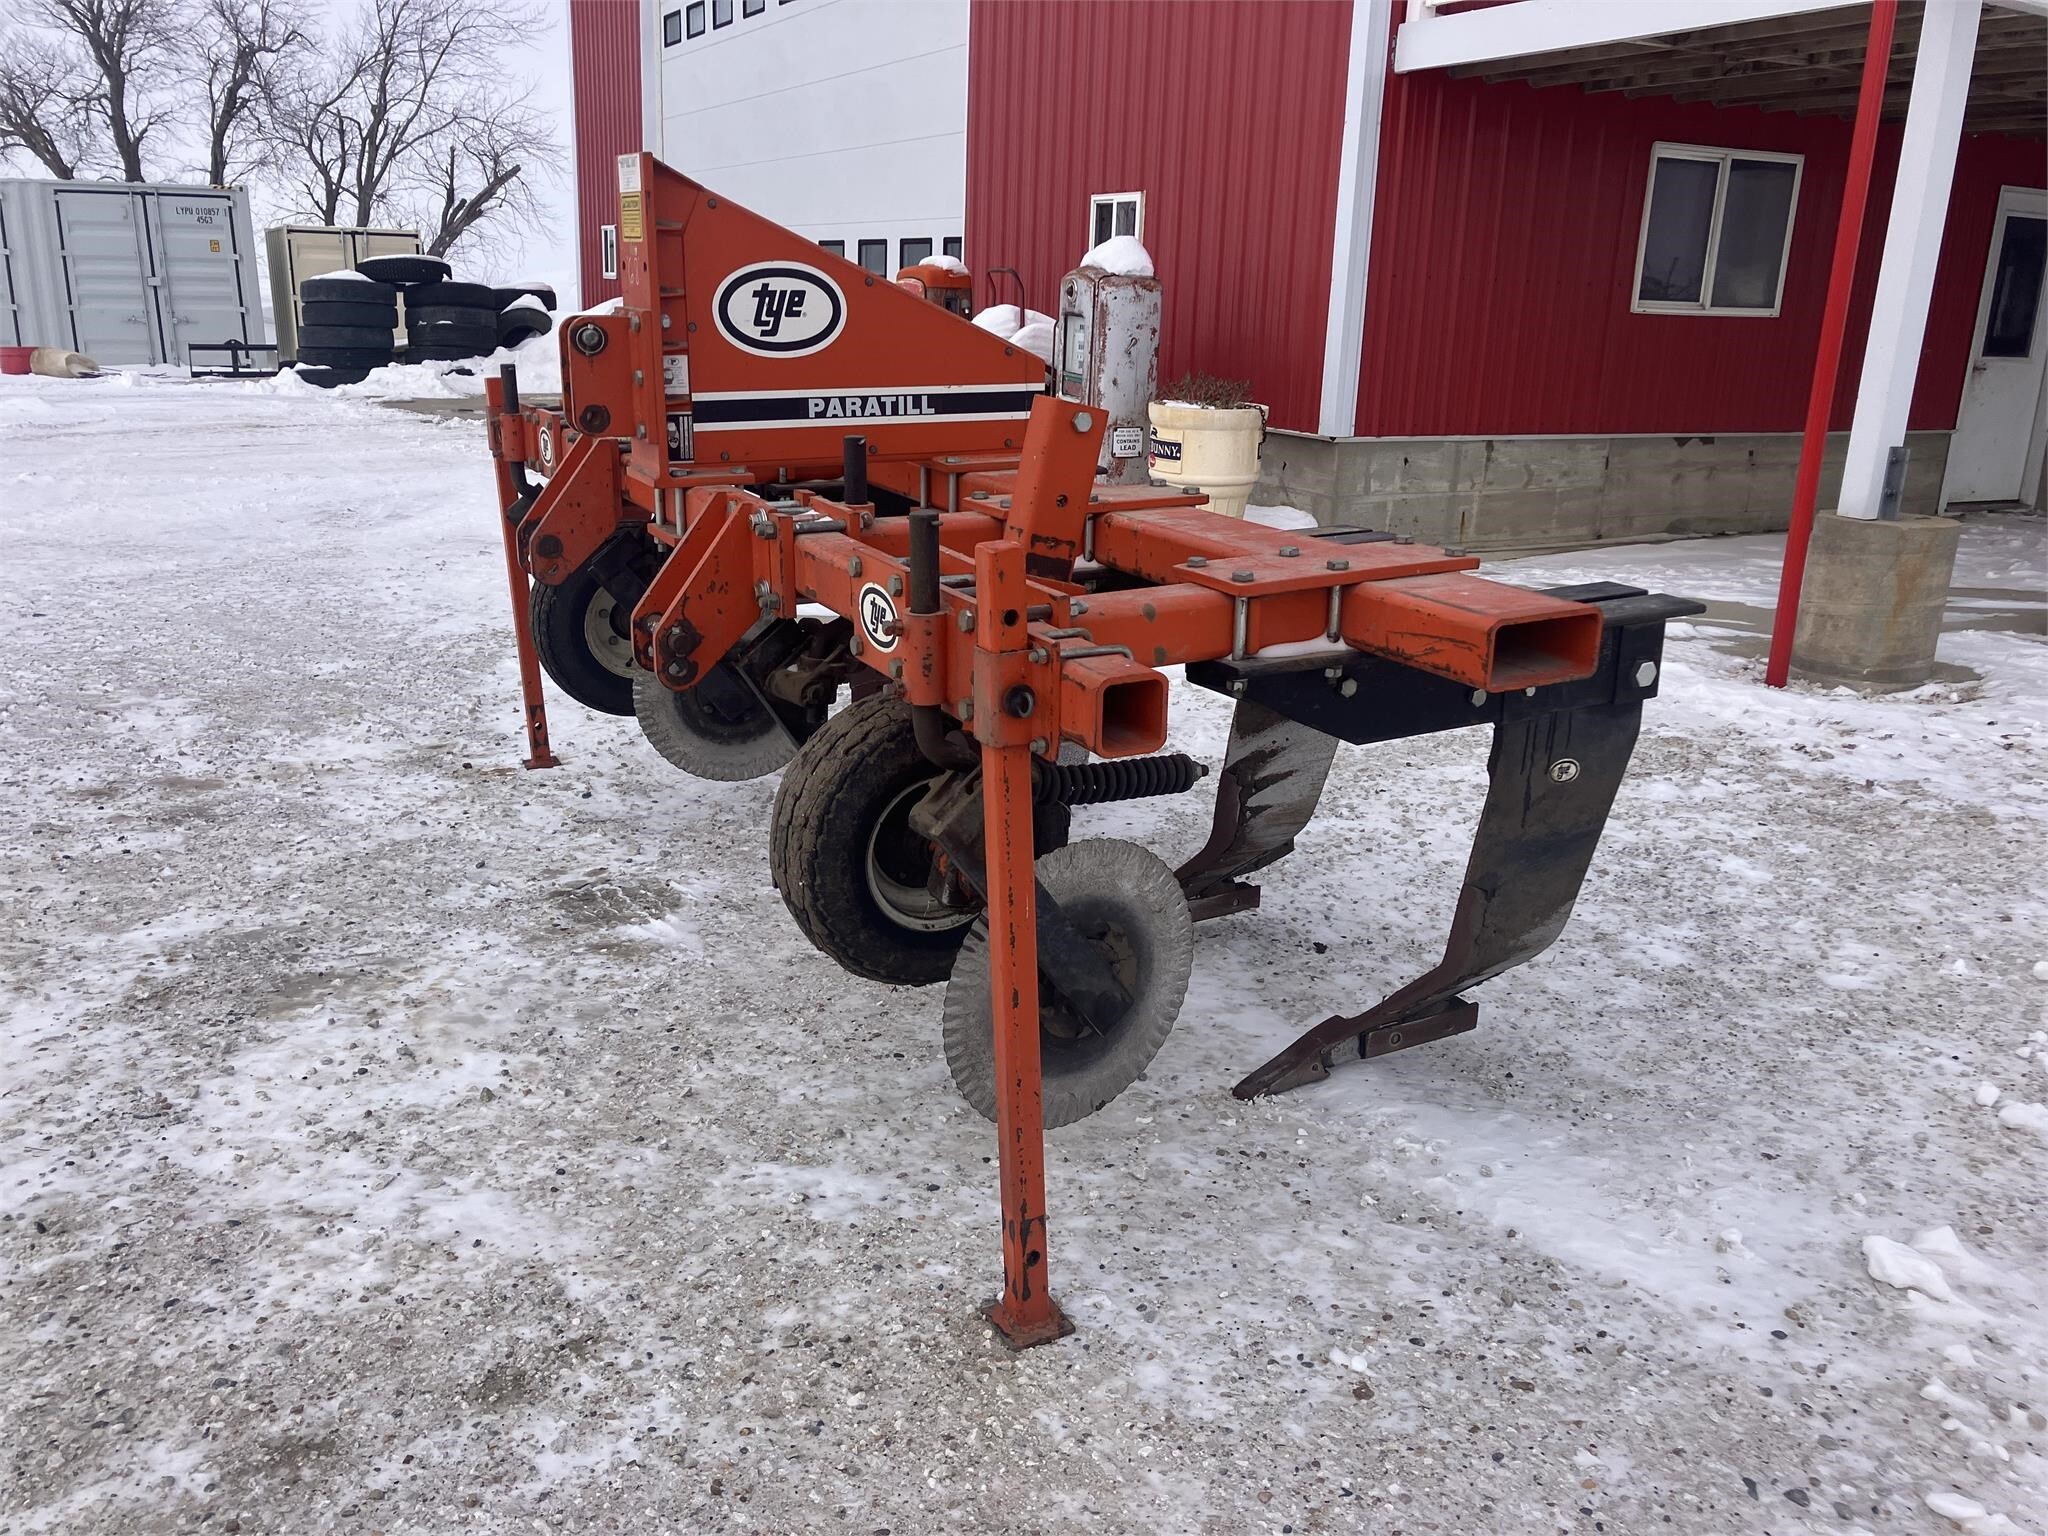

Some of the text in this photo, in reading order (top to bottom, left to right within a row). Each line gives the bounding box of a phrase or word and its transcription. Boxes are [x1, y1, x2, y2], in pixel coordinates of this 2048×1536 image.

[176, 206, 193, 215] LYPU
[195, 207, 220, 216] 010857
[196, 216, 213, 224] 45G3
[752, 282, 806, 337] tye
[808, 395, 935, 418] PARATILL
